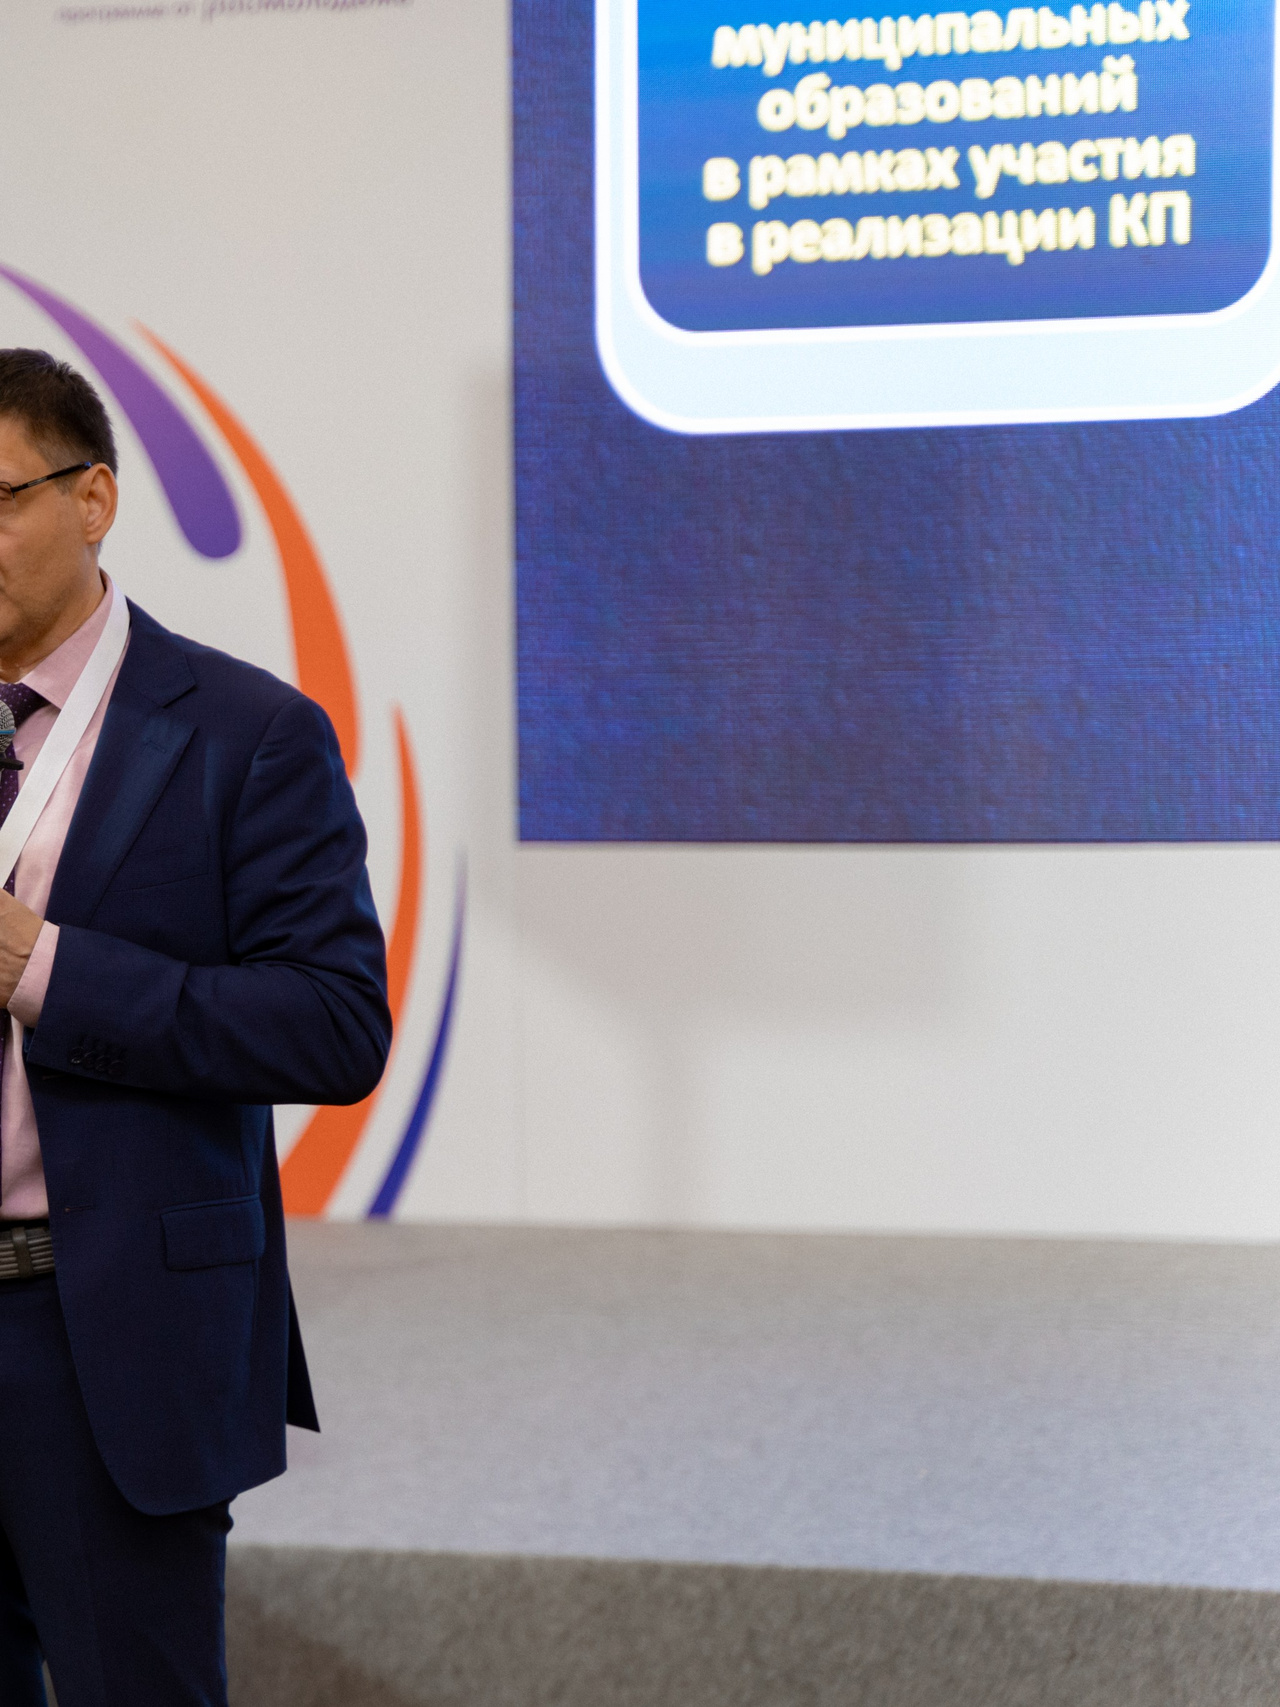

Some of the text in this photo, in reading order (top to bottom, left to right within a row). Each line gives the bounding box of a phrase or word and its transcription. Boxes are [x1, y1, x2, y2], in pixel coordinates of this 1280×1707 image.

[712, 0, 1191, 77] муниципальных
[757, 54, 1139, 140] образований
[703, 134, 1197, 210] в рамках участия
[707, 191, 1192, 276] в реализации КП
